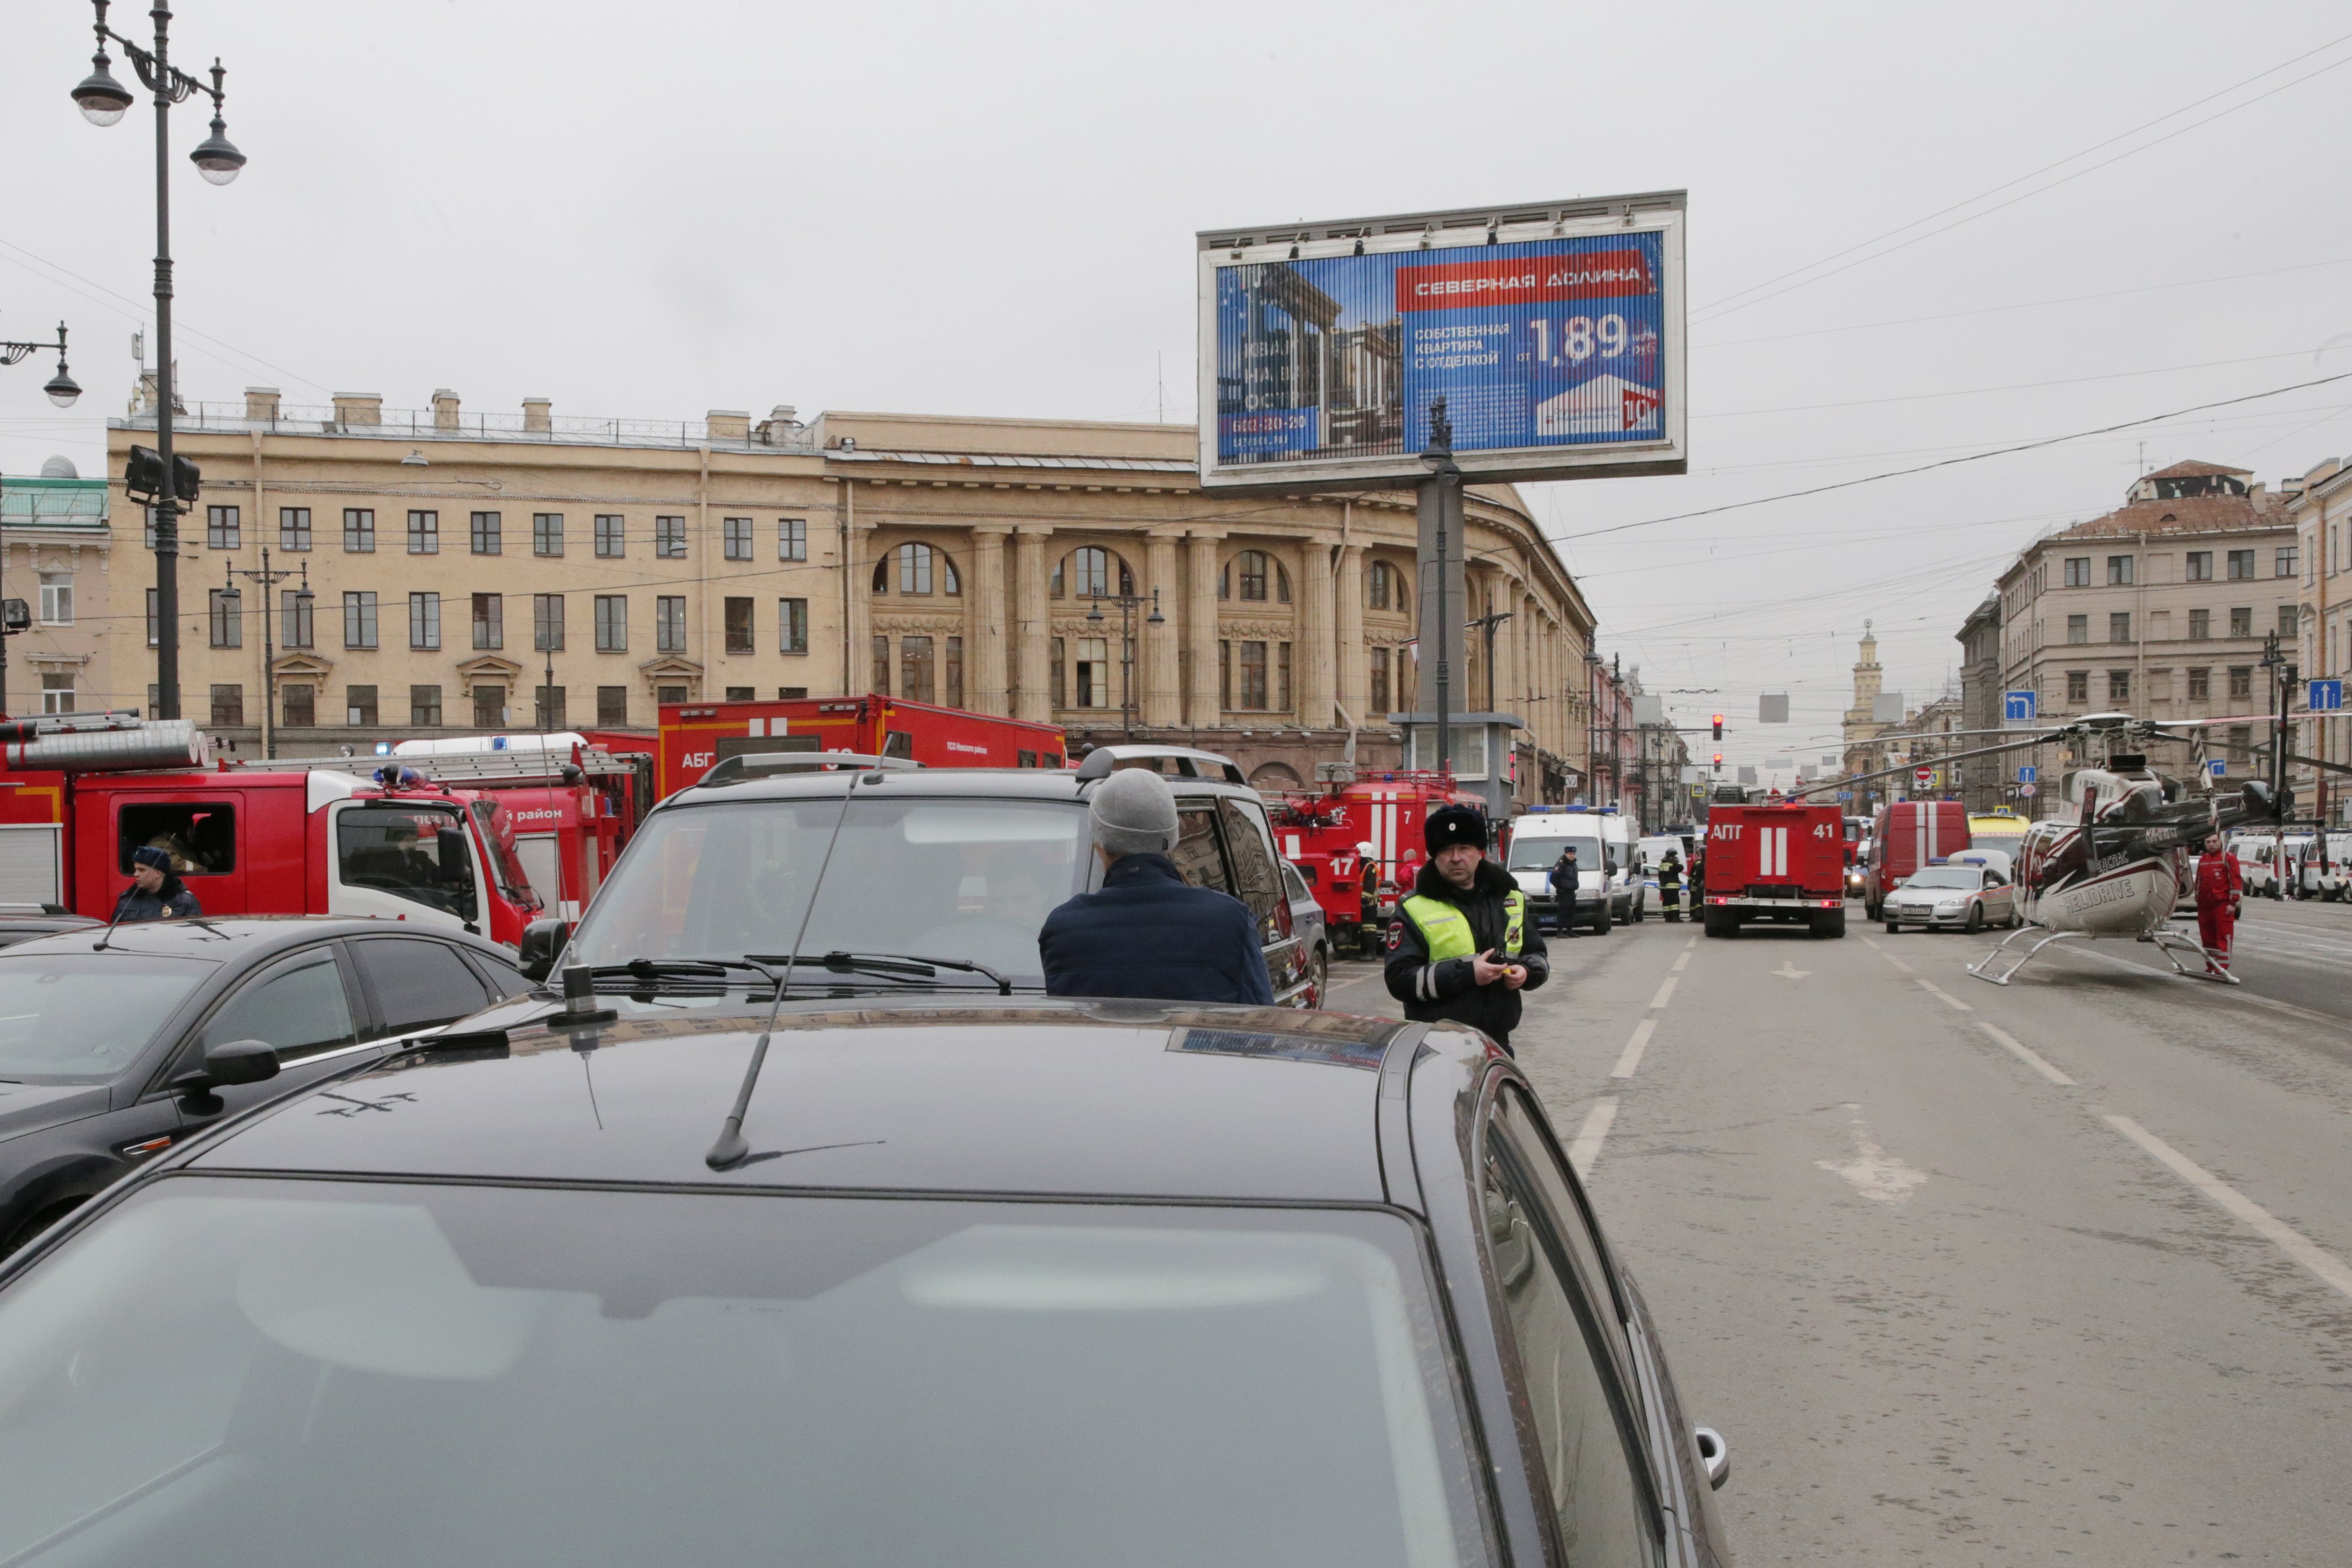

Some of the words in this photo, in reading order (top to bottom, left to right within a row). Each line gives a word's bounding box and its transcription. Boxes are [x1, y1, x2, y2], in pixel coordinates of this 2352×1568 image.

[1415, 274, 1536, 296] СЕВЕРНАЯ
[1546, 267, 1640, 287] ДОЛИНА
[1415, 323, 1509, 340] СОБСТВЕННАЯ
[1415, 340, 1483, 354] КВАРТИРА
[1531, 314, 1627, 367] 1,89
[1415, 357, 1423, 369] С
[1427, 350, 1498, 369] ОТДЕЛКОЙ
[682, 752, 714, 768] АБГ
[517, 809, 562, 823] район
[1404, 811, 1411, 824] 7
[1710, 824, 1743, 839] АПТ
[1813, 824, 1833, 838] 41
[1329, 858, 1354, 876] 17
[2063, 879, 2135, 915] HELIDRIVE
